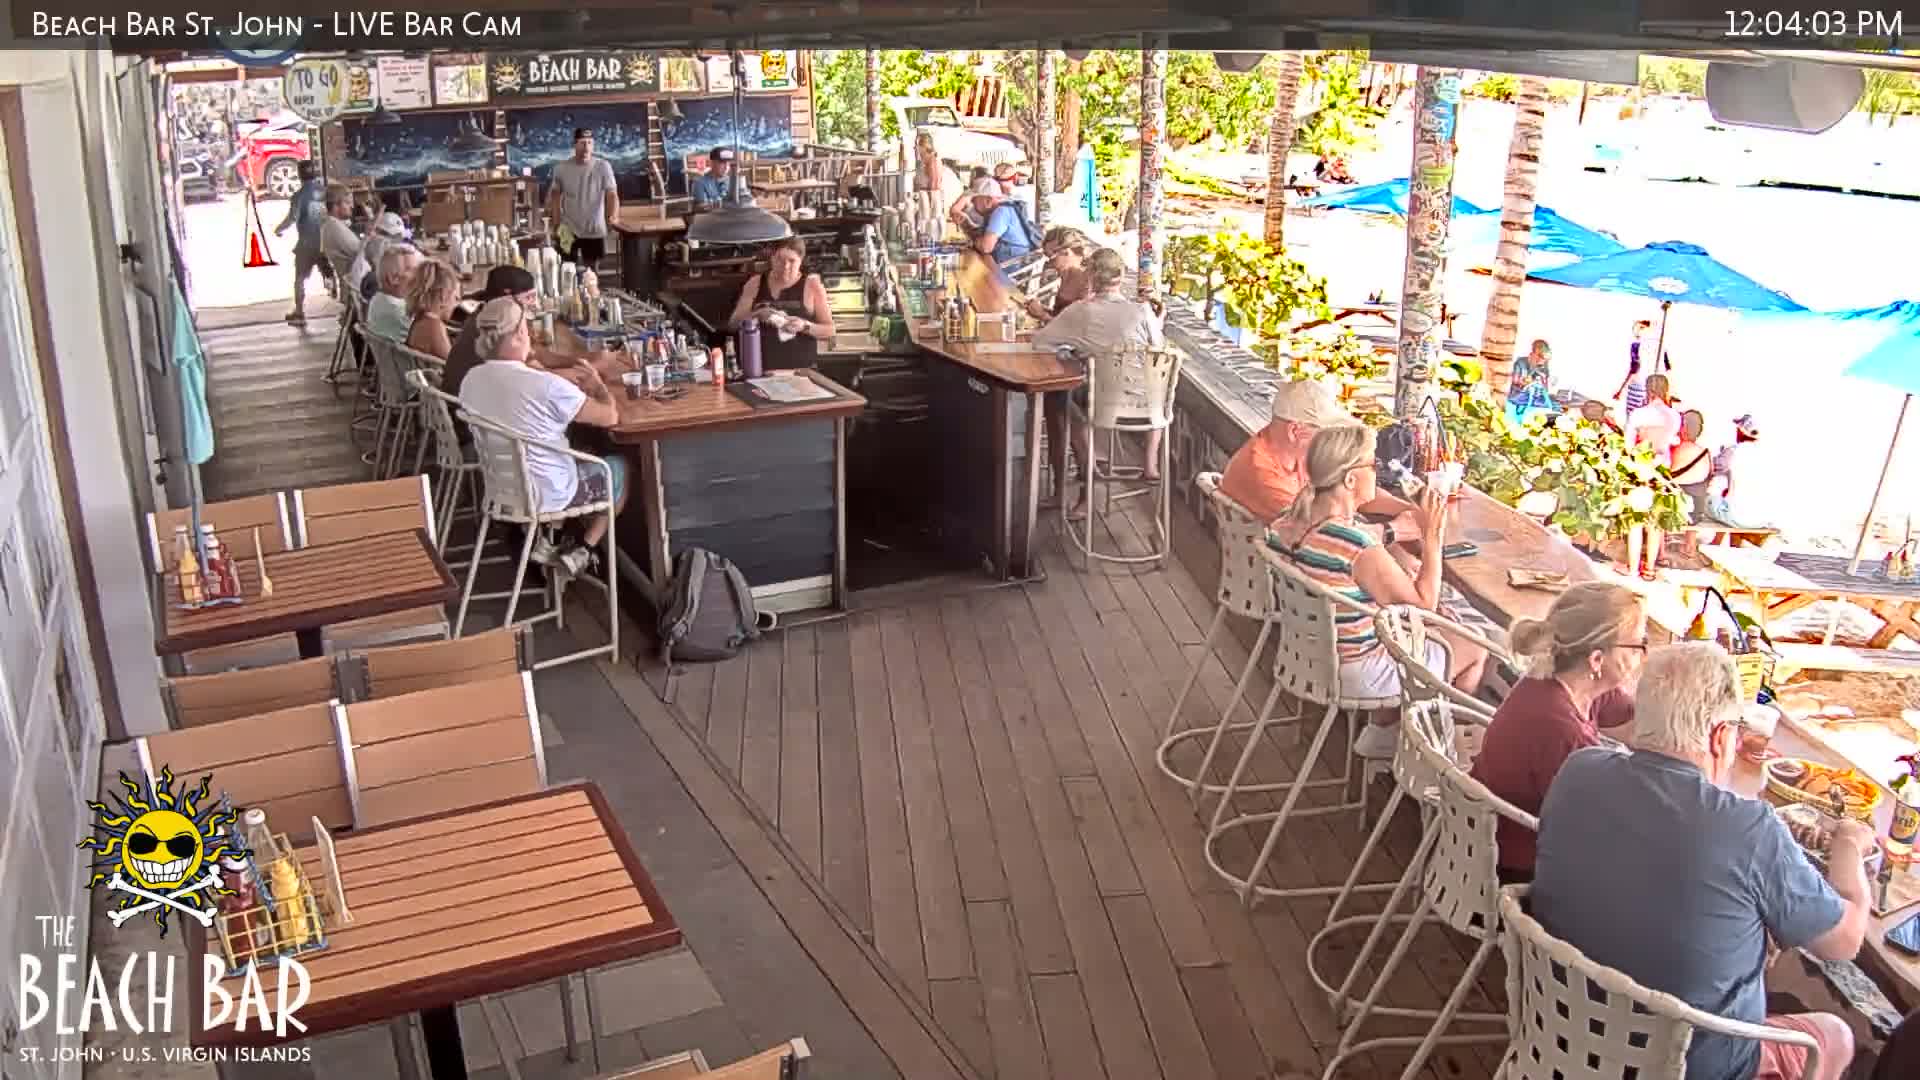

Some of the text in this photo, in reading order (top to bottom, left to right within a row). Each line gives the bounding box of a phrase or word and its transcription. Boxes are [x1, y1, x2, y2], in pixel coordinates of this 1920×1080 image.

[292, 64, 338, 91] TO GO
[529, 57, 622, 83] BEACH BAR
